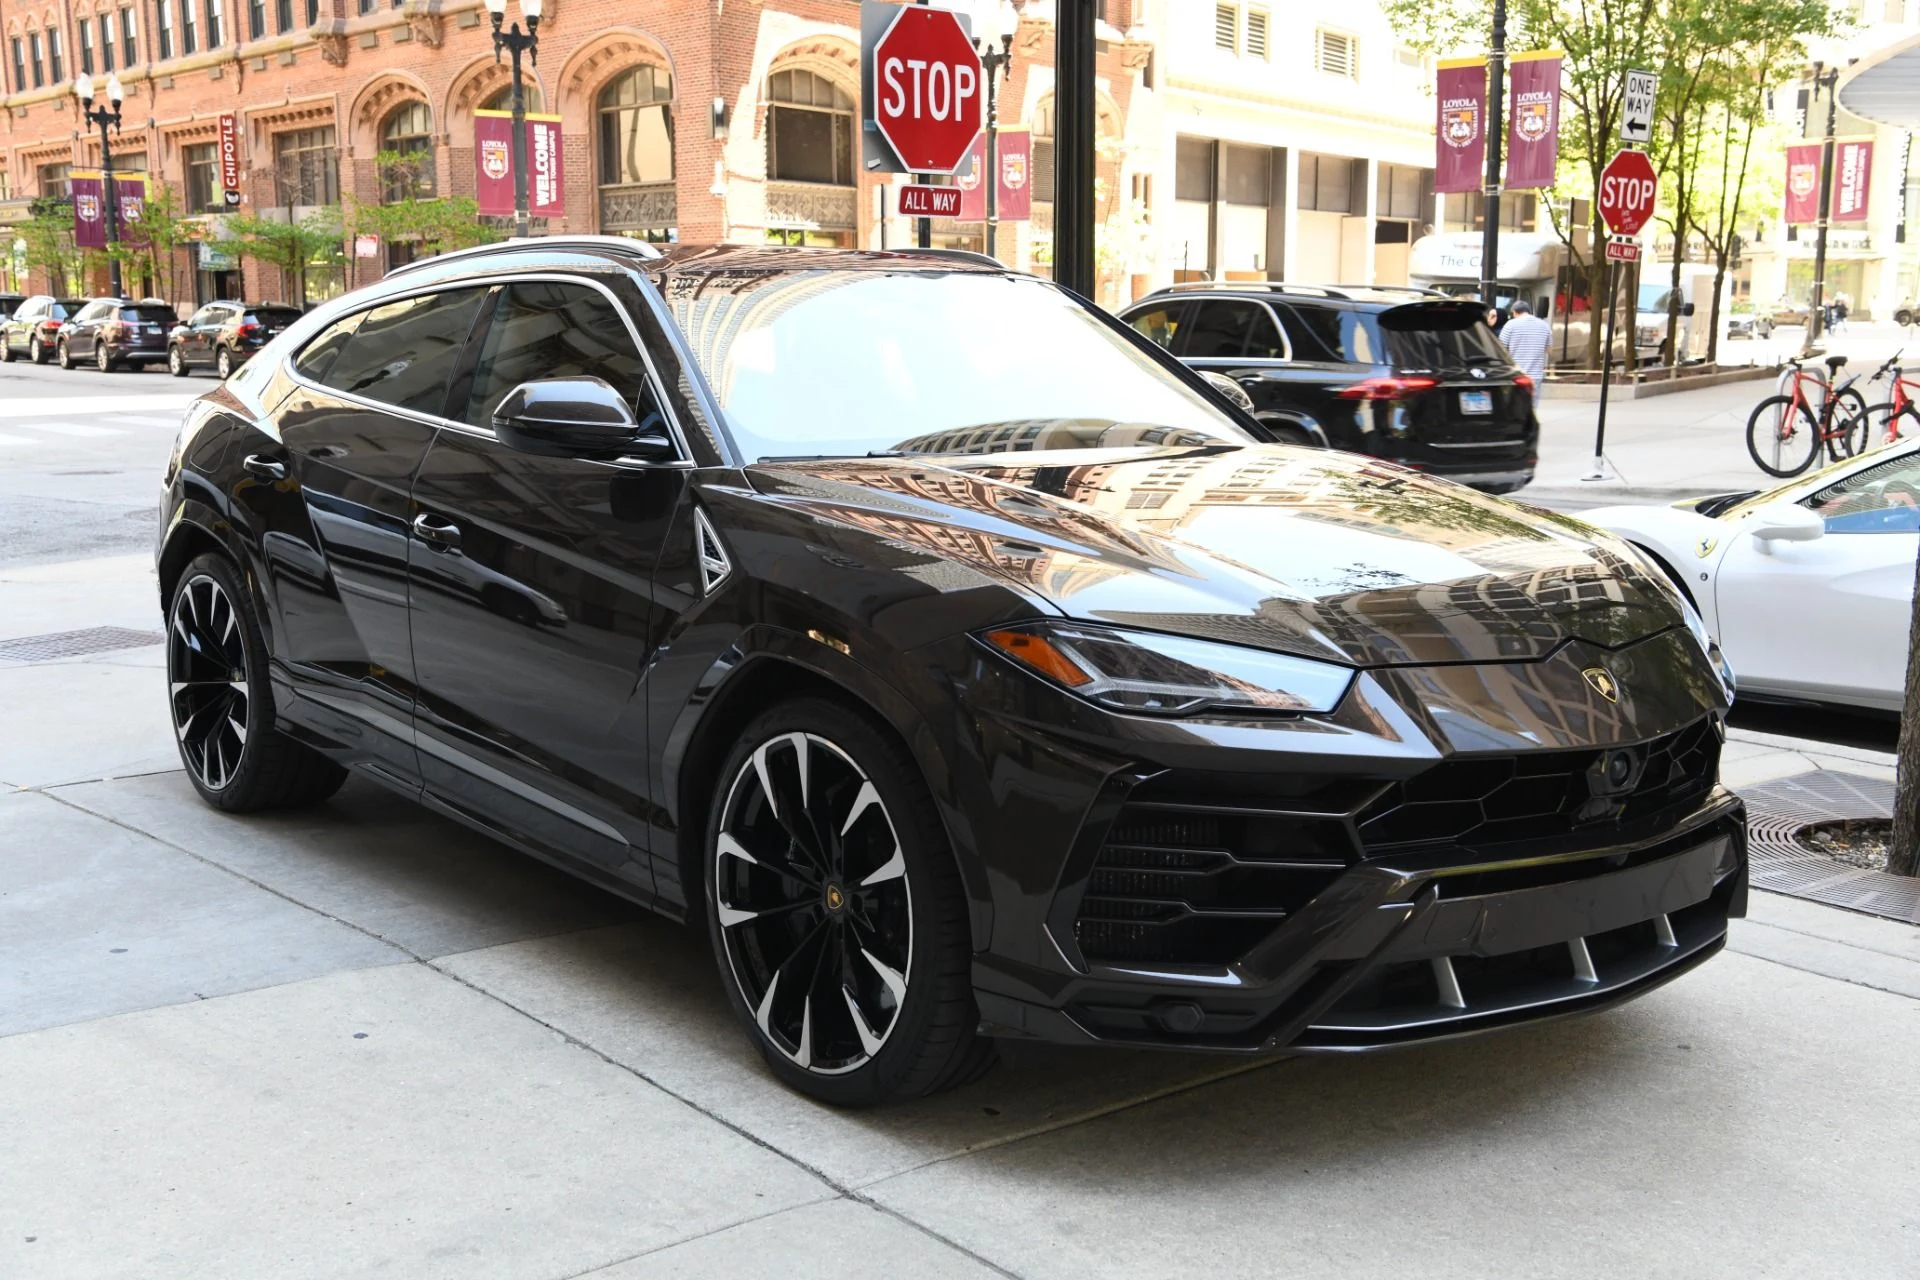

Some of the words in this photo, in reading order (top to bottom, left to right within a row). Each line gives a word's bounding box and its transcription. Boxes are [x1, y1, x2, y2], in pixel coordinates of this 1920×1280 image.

[883, 56, 976, 122] STOP
[1629, 76, 1652, 95] ONE
[1443, 98, 1478, 108] LOYOLA
[1517, 91, 1552, 101] LOYOLA
[1627, 97, 1651, 114] WAY
[222, 117, 237, 187] CHIPOTLE
[533, 124, 549, 206] WELCOME
[1839, 144, 1859, 214] WELCOME
[904, 191, 928, 211] ALL
[932, 192, 957, 212] WAY
[1602, 175, 1654, 211] STOP
[1440, 254, 1464, 267] The
[1608, 243, 1622, 257] ALL
[1623, 244, 1636, 258] WAY
